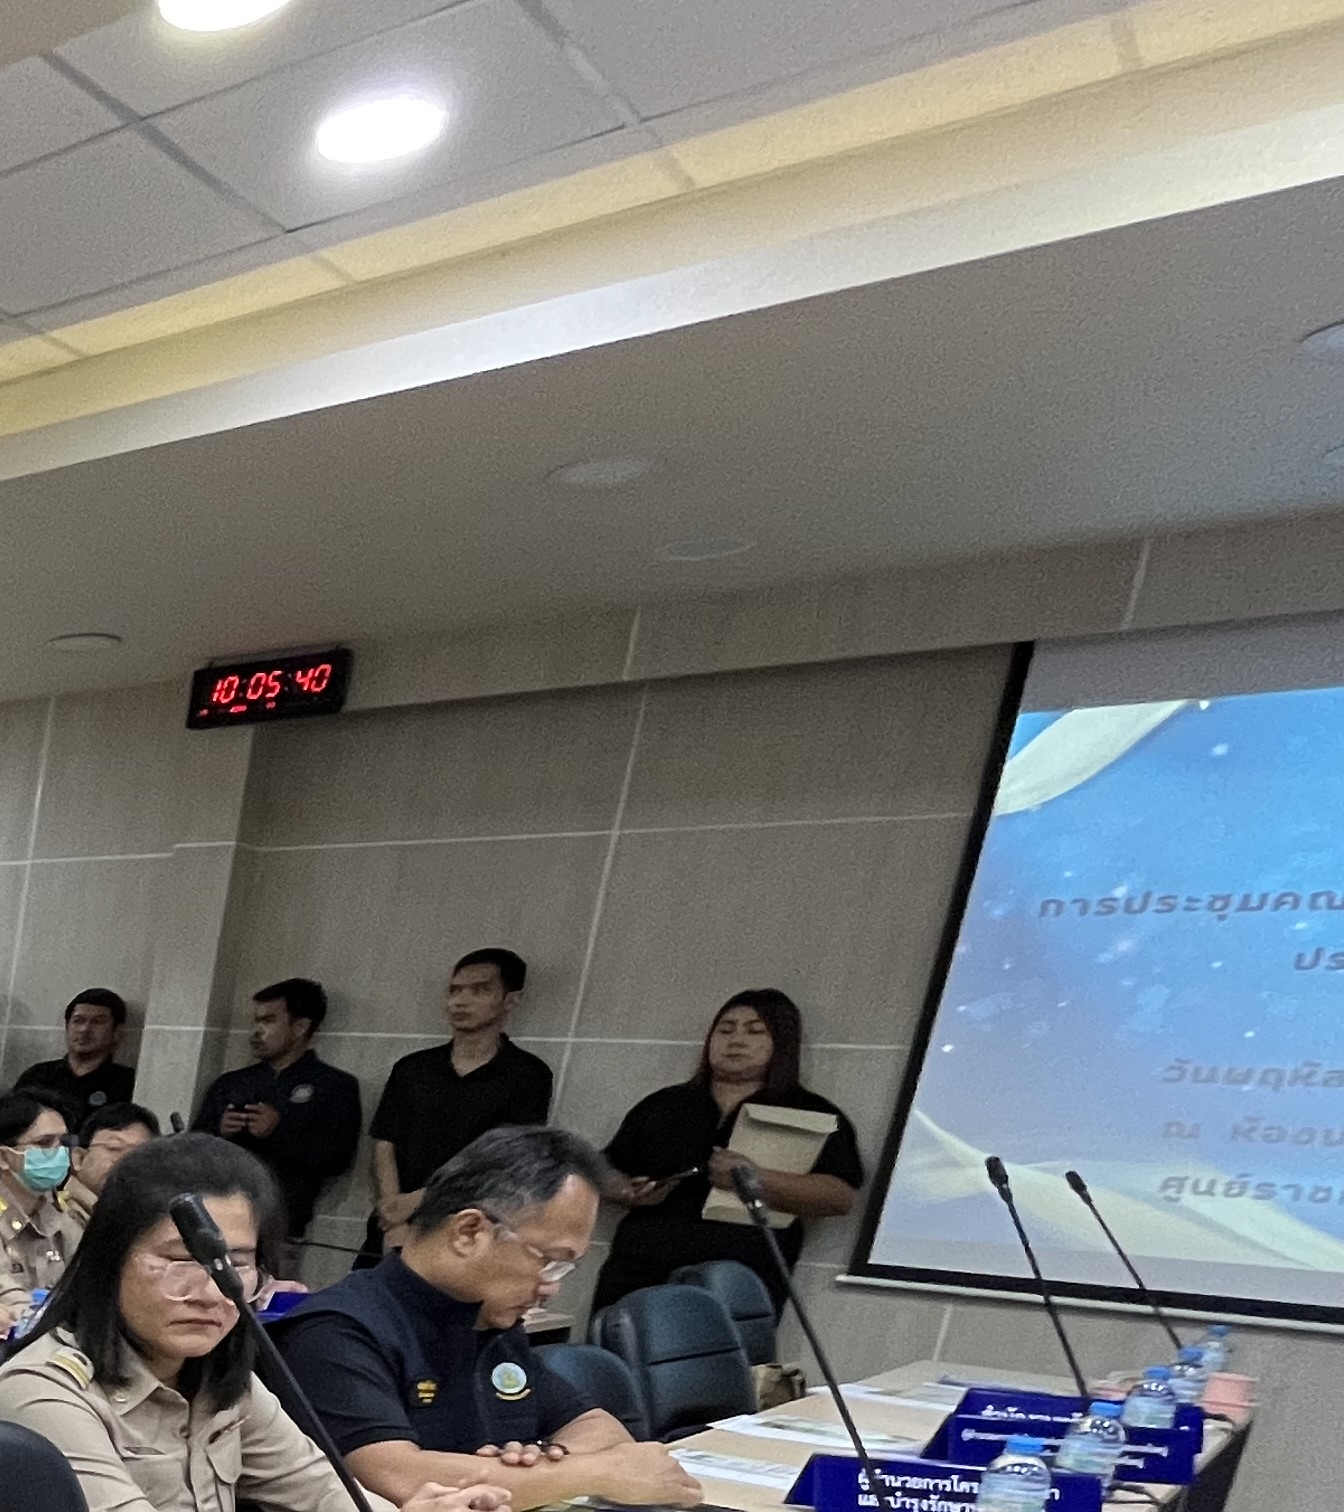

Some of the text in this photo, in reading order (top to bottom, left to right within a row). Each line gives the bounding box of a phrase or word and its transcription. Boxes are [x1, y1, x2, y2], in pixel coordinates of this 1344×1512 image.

[1039, 890, 1344, 922] การประชุมคณ
[1162, 1058, 1344, 1094] วันพฤหัส
[1158, 1172, 1344, 1205] ศูนย์ราช
